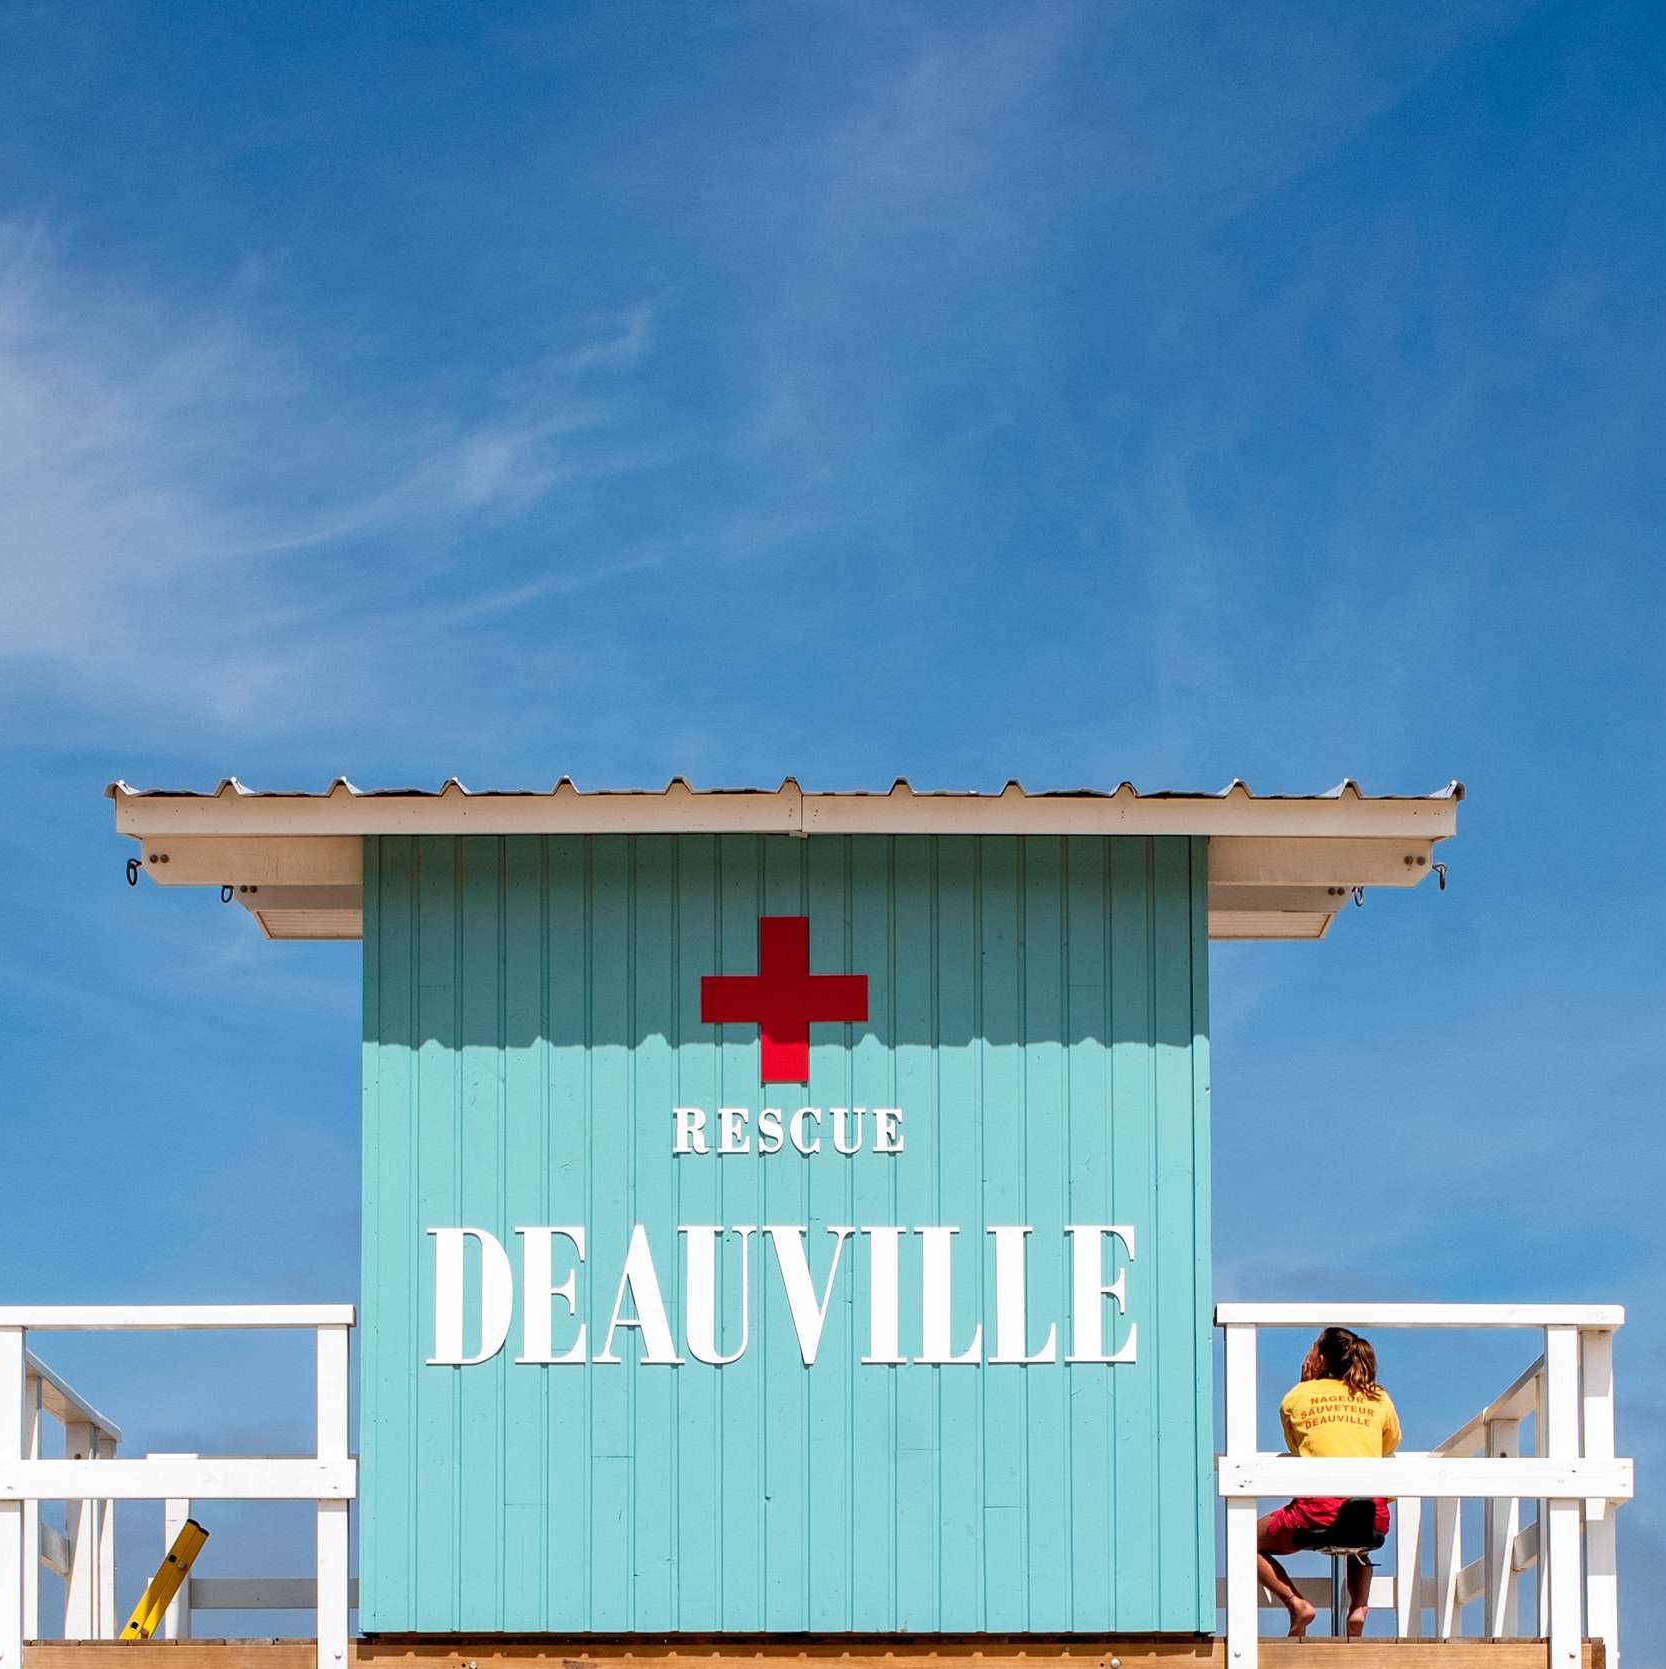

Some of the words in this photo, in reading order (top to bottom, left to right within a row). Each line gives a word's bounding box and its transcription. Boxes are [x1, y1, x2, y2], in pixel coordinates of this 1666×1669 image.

[671, 1106, 906, 1154] RESCUE
[425, 1223, 1138, 1366] DEAUVILLE
[1310, 1395, 1364, 1405] NAGEUR
[1300, 1404, 1374, 1419] SAUVETEUR
[1305, 1414, 1371, 1430] DEAUVILLE
